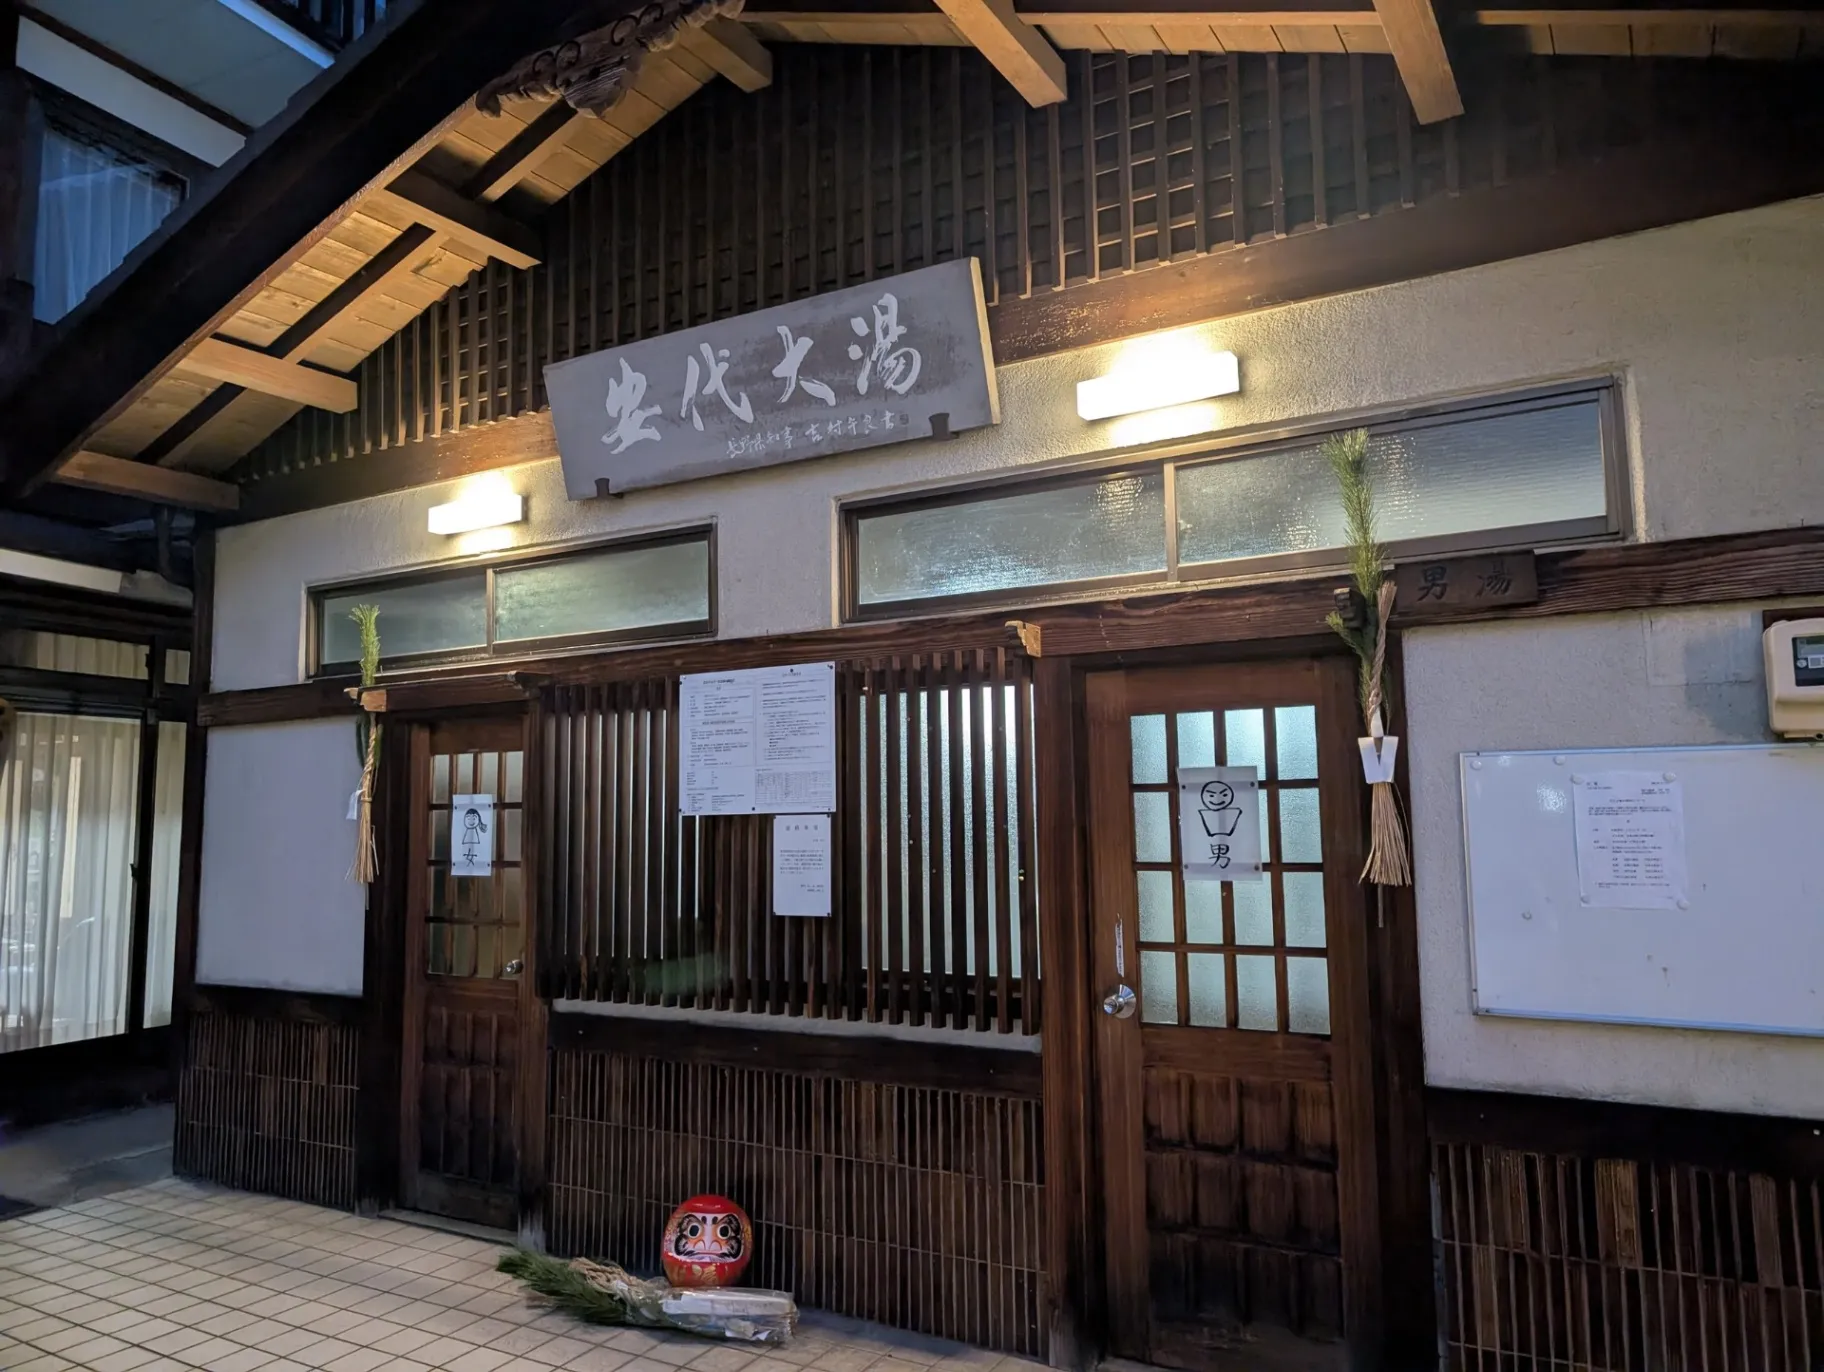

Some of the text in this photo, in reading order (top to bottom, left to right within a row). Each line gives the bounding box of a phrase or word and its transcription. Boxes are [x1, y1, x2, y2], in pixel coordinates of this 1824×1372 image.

[600, 293, 922, 455] 安代大湯
[1416, 559, 1514, 602] 男湯
[462, 848, 478, 868] 女
[1208, 843, 1232, 869] 男
